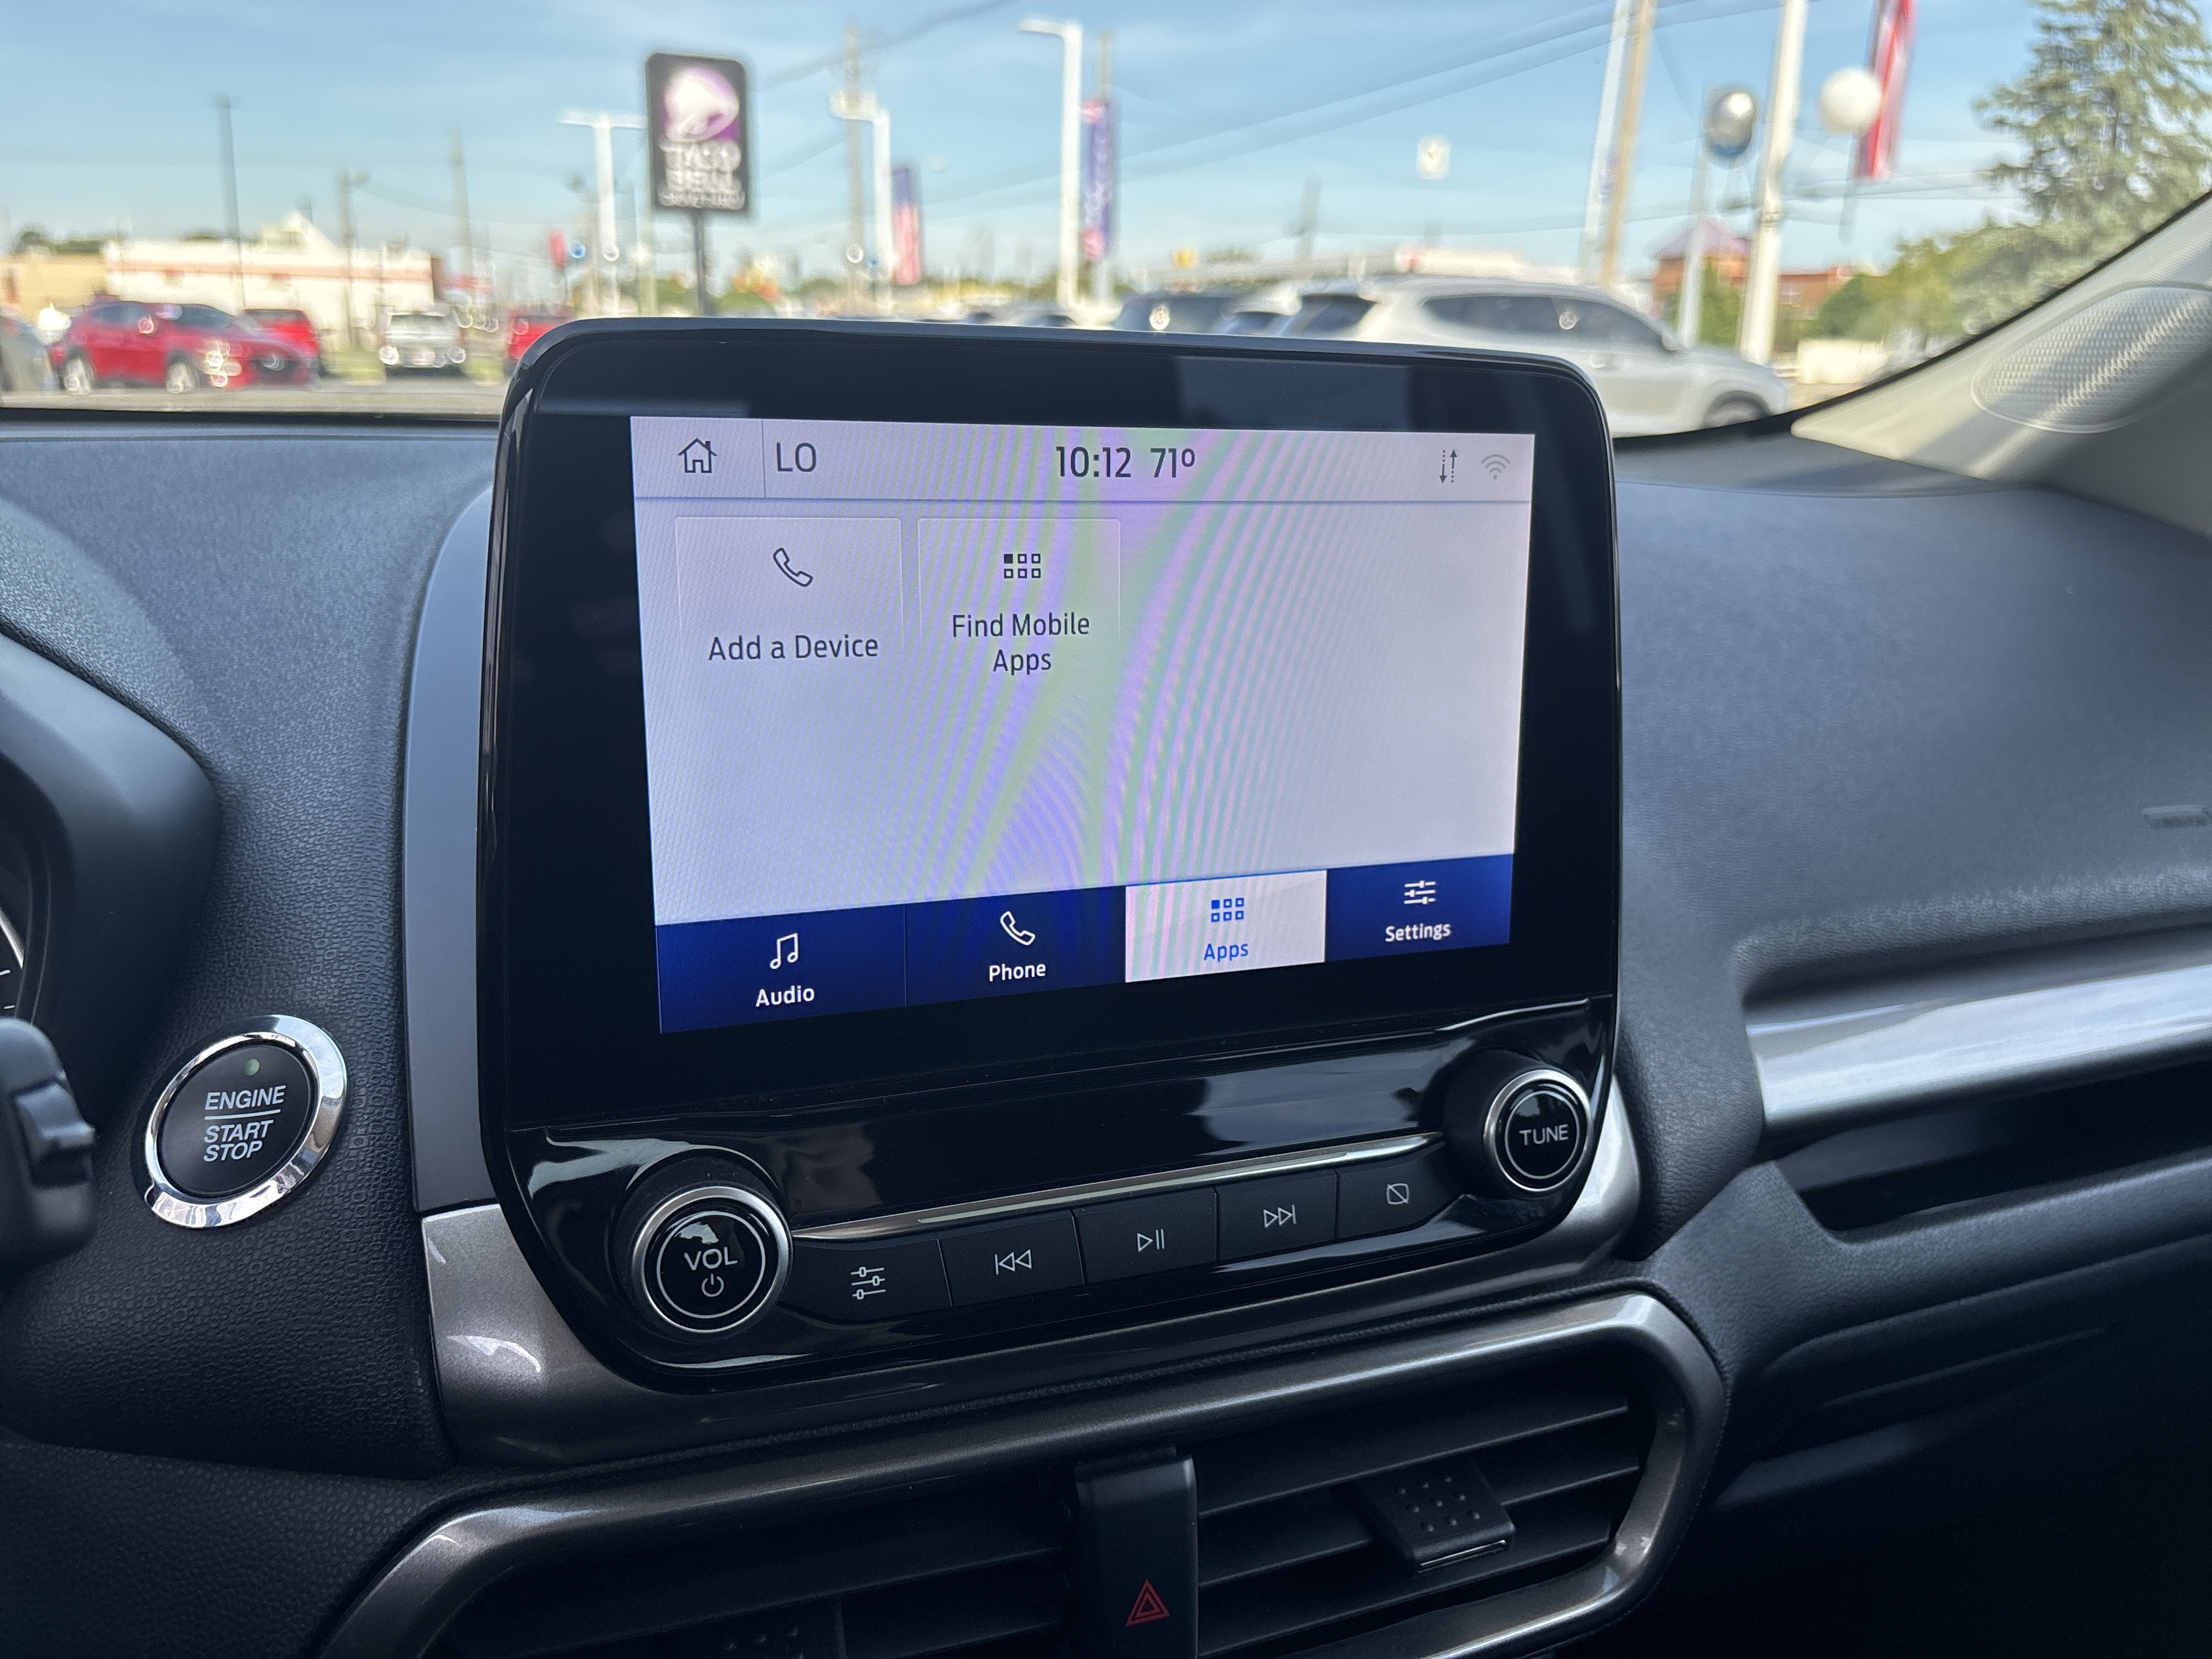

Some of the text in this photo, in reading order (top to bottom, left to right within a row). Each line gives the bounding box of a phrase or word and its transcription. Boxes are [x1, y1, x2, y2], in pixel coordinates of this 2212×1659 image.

[776, 442, 817, 472] LO
[1056, 446, 1132, 478] 10:12
[953, 612, 1090, 637] Find Mobile
[708, 634, 878, 661] Add a Device
[992, 649, 1052, 676] Apps
[1385, 923, 1451, 942] Settings
[1203, 943, 1249, 962] Apps
[989, 963, 1046, 982] Phone
[755, 985, 815, 1007] Audio
[205, 1085, 287, 1110] ENGINE
[204, 1119, 274, 1143] START
[1519, 1124, 1569, 1146] TUNE
[203, 1140, 263, 1162] STOP
[684, 1246, 738, 1271] VOL
